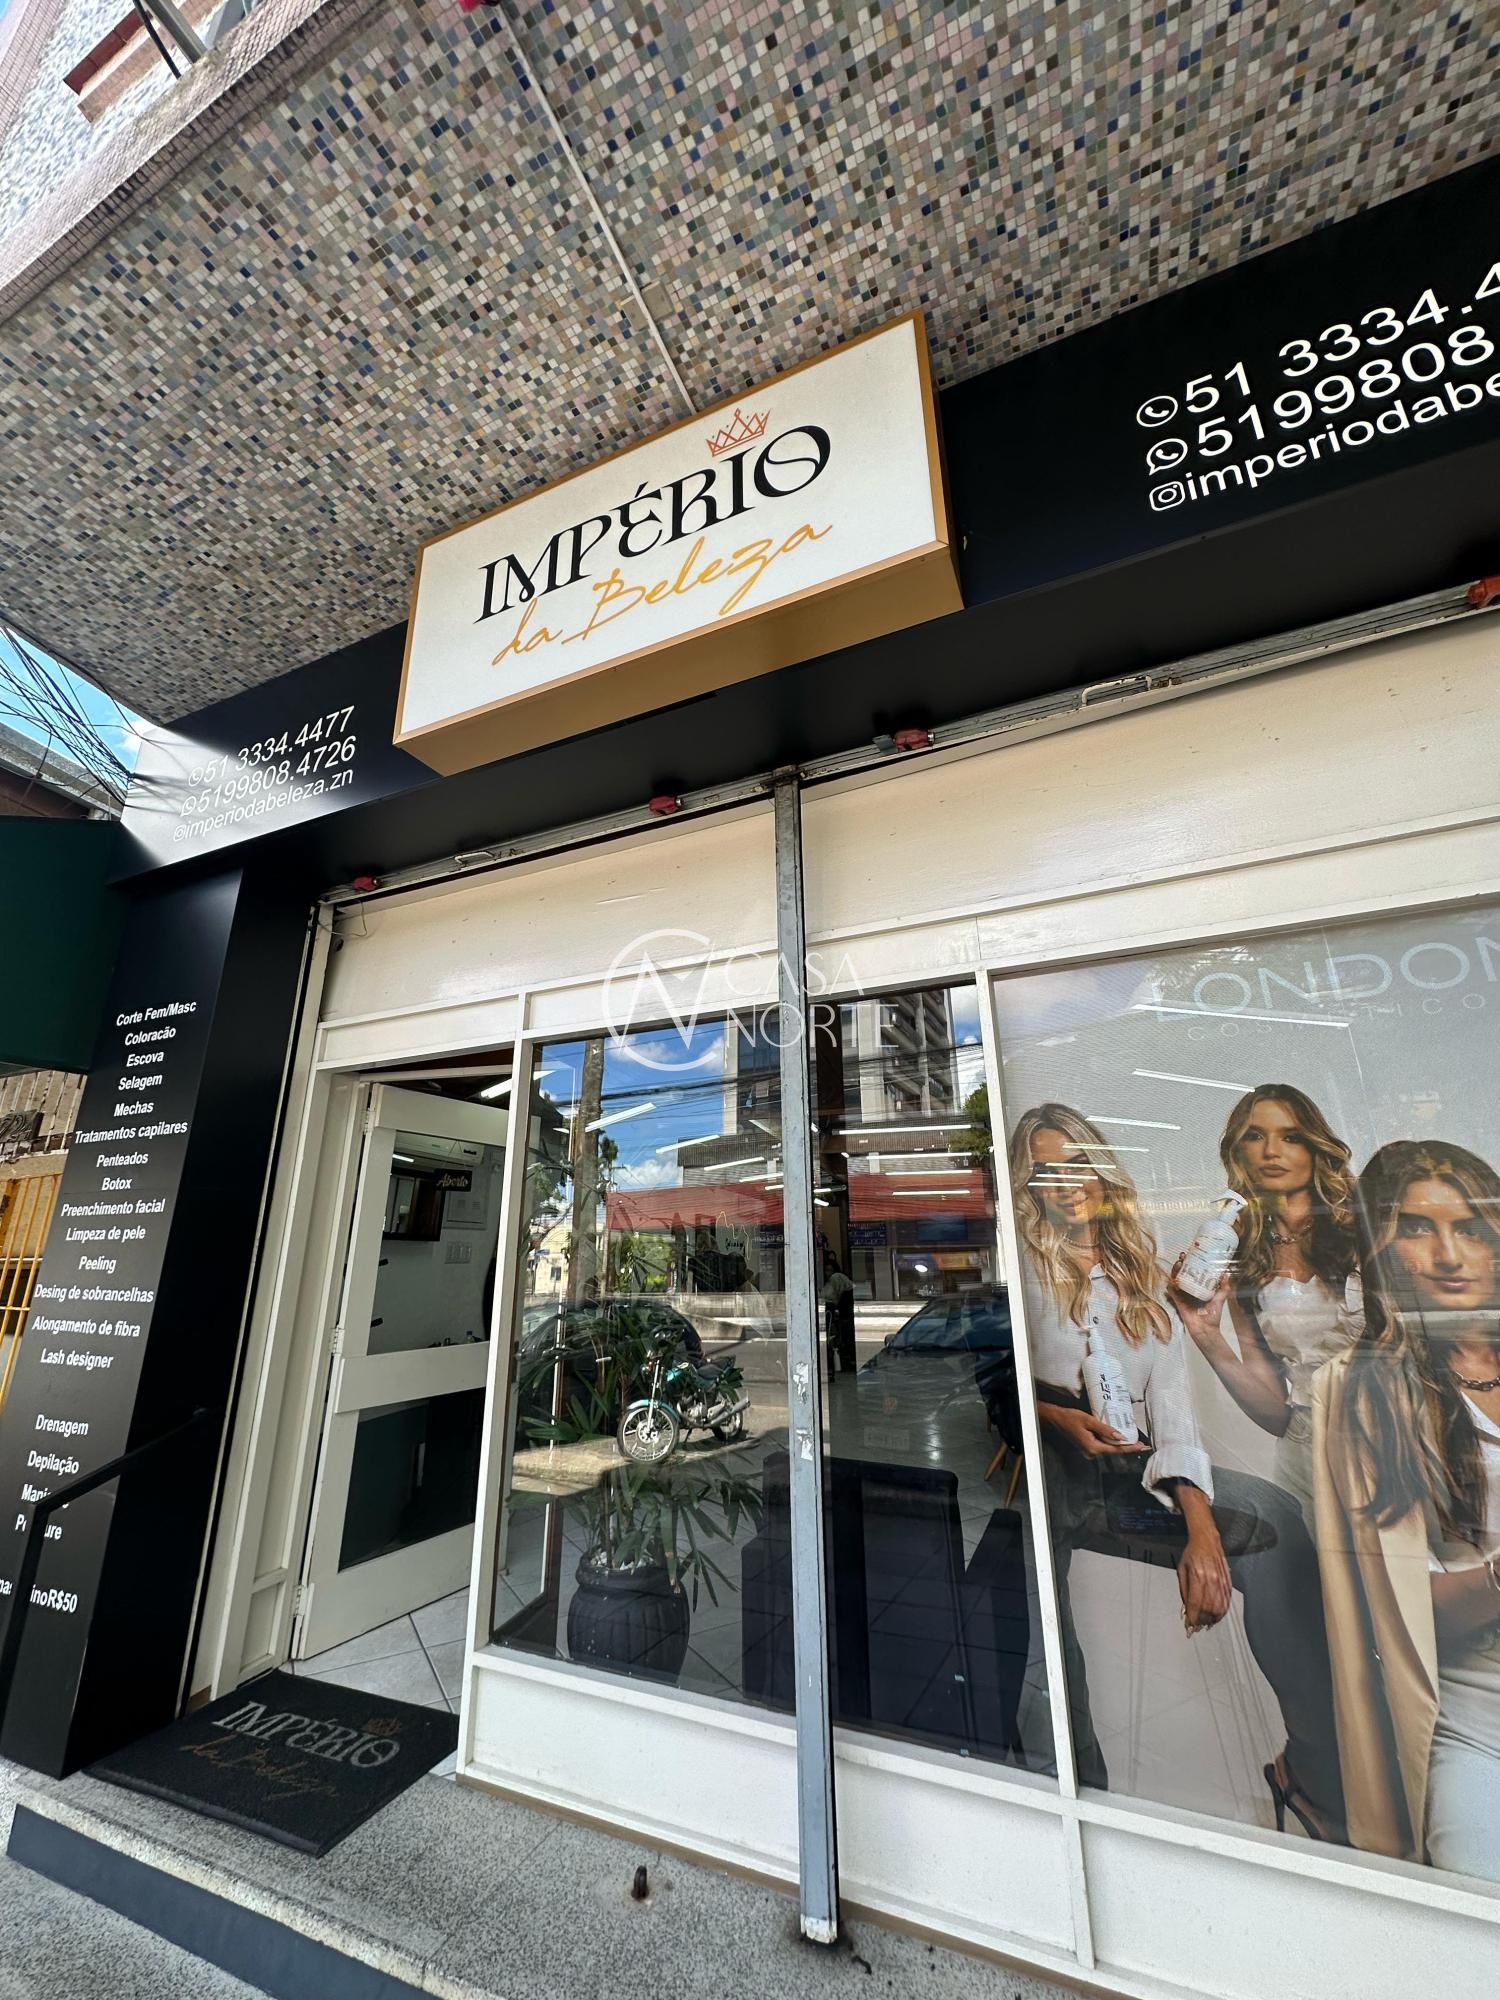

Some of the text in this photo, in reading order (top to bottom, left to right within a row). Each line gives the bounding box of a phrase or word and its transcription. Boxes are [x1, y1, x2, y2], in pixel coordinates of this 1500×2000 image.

[1186, 362, 1250, 413] 51
[1199, 326, 1494, 456] 5199808
[473, 425, 831, 625] IMPÉRIO
[561, 523, 833, 644] Beleza
[203, 705, 355, 784] 51 3334.4477
[197, 736, 357, 813] 5199808.4726
[184, 769, 353, 839] imperiodabeleza.zn
[116, 1001, 197, 1027] Corte Fem/Masc
[126, 1051, 164, 1067] Escova
[118, 1073, 163, 1091] Selagem
[113, 1100, 154, 1117] Mechas
[74, 1121, 188, 1144] Tratamentos capilares
[96, 1151, 149, 1168] Penteados
[101, 1177, 132, 1191] Botox
[61, 1198, 166, 1217] Preenchimento facial
[65, 1225, 146, 1243] Limpeza de pele
[78, 1255, 117, 1274] Peeling
[33, 1283, 155, 1303] Desing de sobrancelhas
[31, 1315, 141, 1337] Alongamento de fibra
[40, 1348, 114, 1371] Lash designer
[35, 1414, 89, 1437] Drenagem
[27, 1450, 80, 1476] Depilação
[15, 1513, 63, 1541] Pure
[210, 1701, 400, 1768] IMPÉRIO
